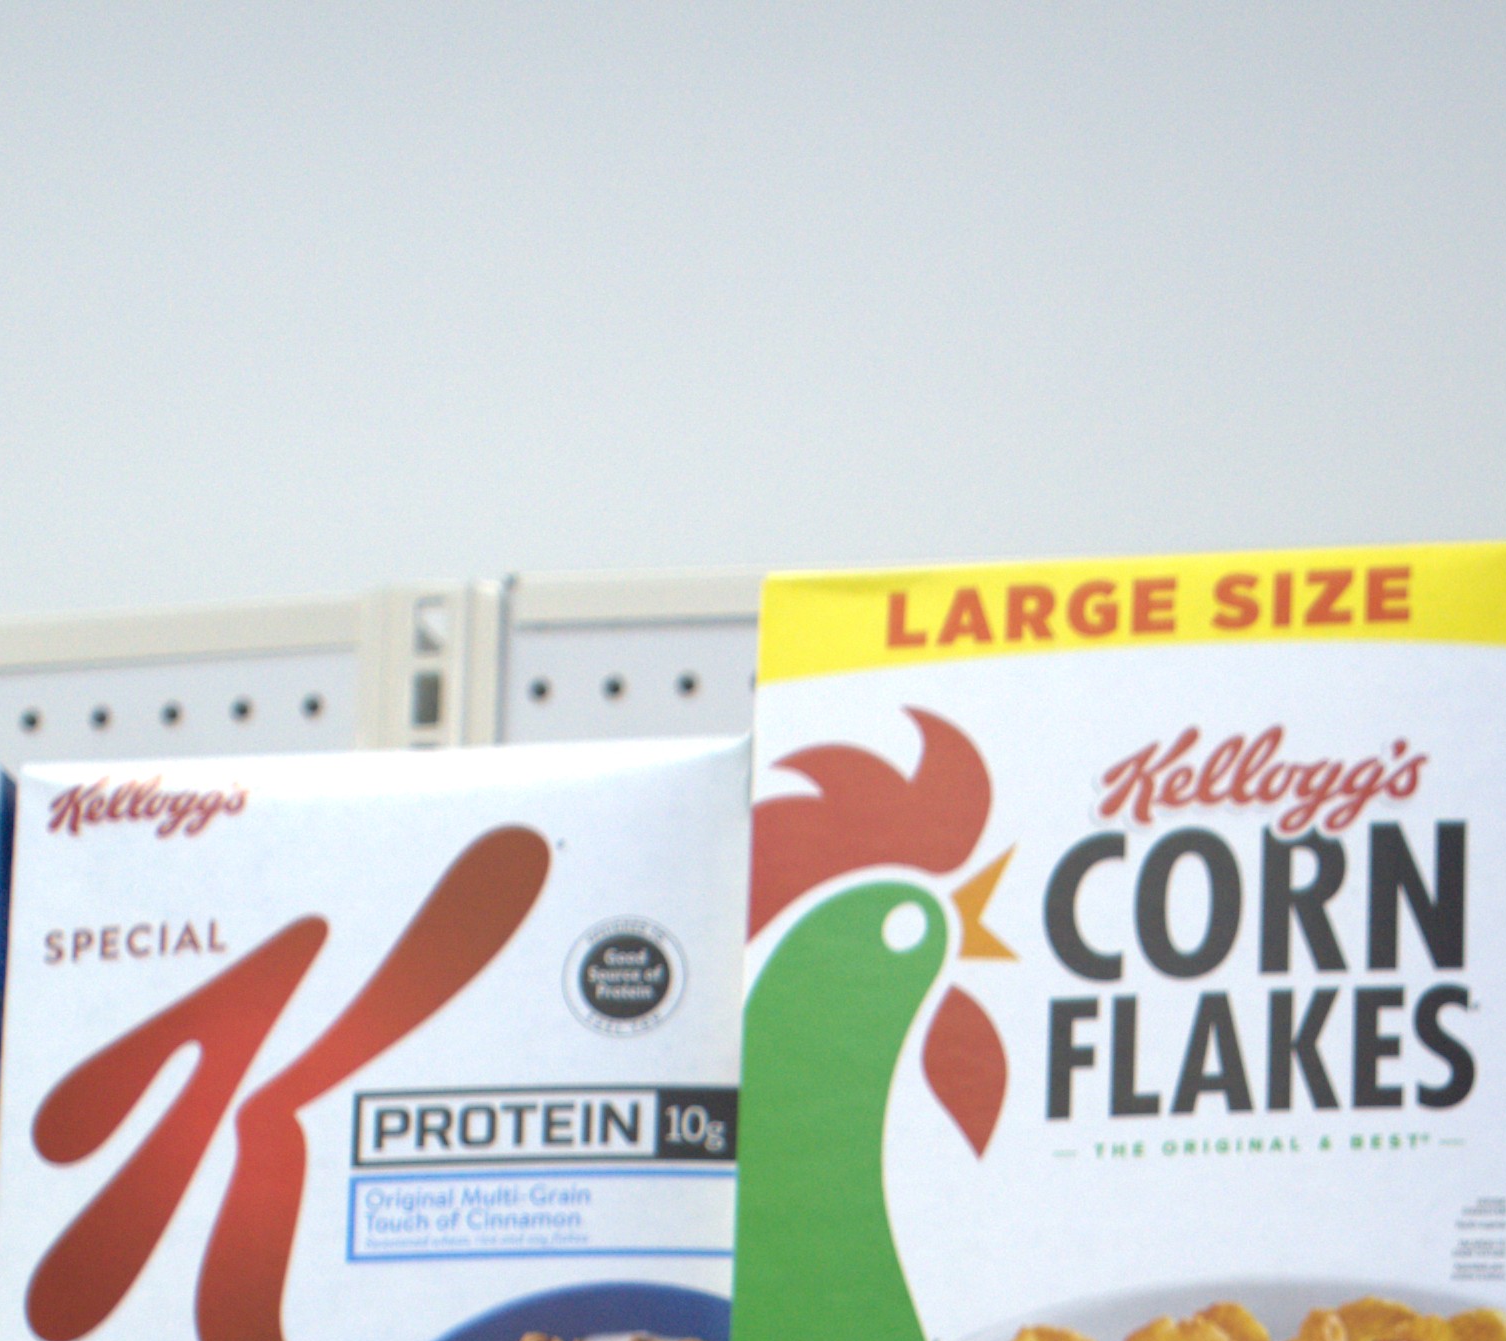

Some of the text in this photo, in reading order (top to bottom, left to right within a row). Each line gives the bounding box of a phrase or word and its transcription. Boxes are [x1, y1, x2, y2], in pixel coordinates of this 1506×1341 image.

[886, 565, 1413, 650] LARGE SIZE
[49, 777, 248, 838] Kellogg's
[1098, 725, 1429, 834] Kellogg's
[1043, 820, 1468, 982] CORN
[44, 920, 227, 964] SPECIAL
[1046, 984, 1476, 1121] FLAKES
[373, 1101, 641, 1151] PROTEIN
[664, 1104, 725, 1151] 10g
